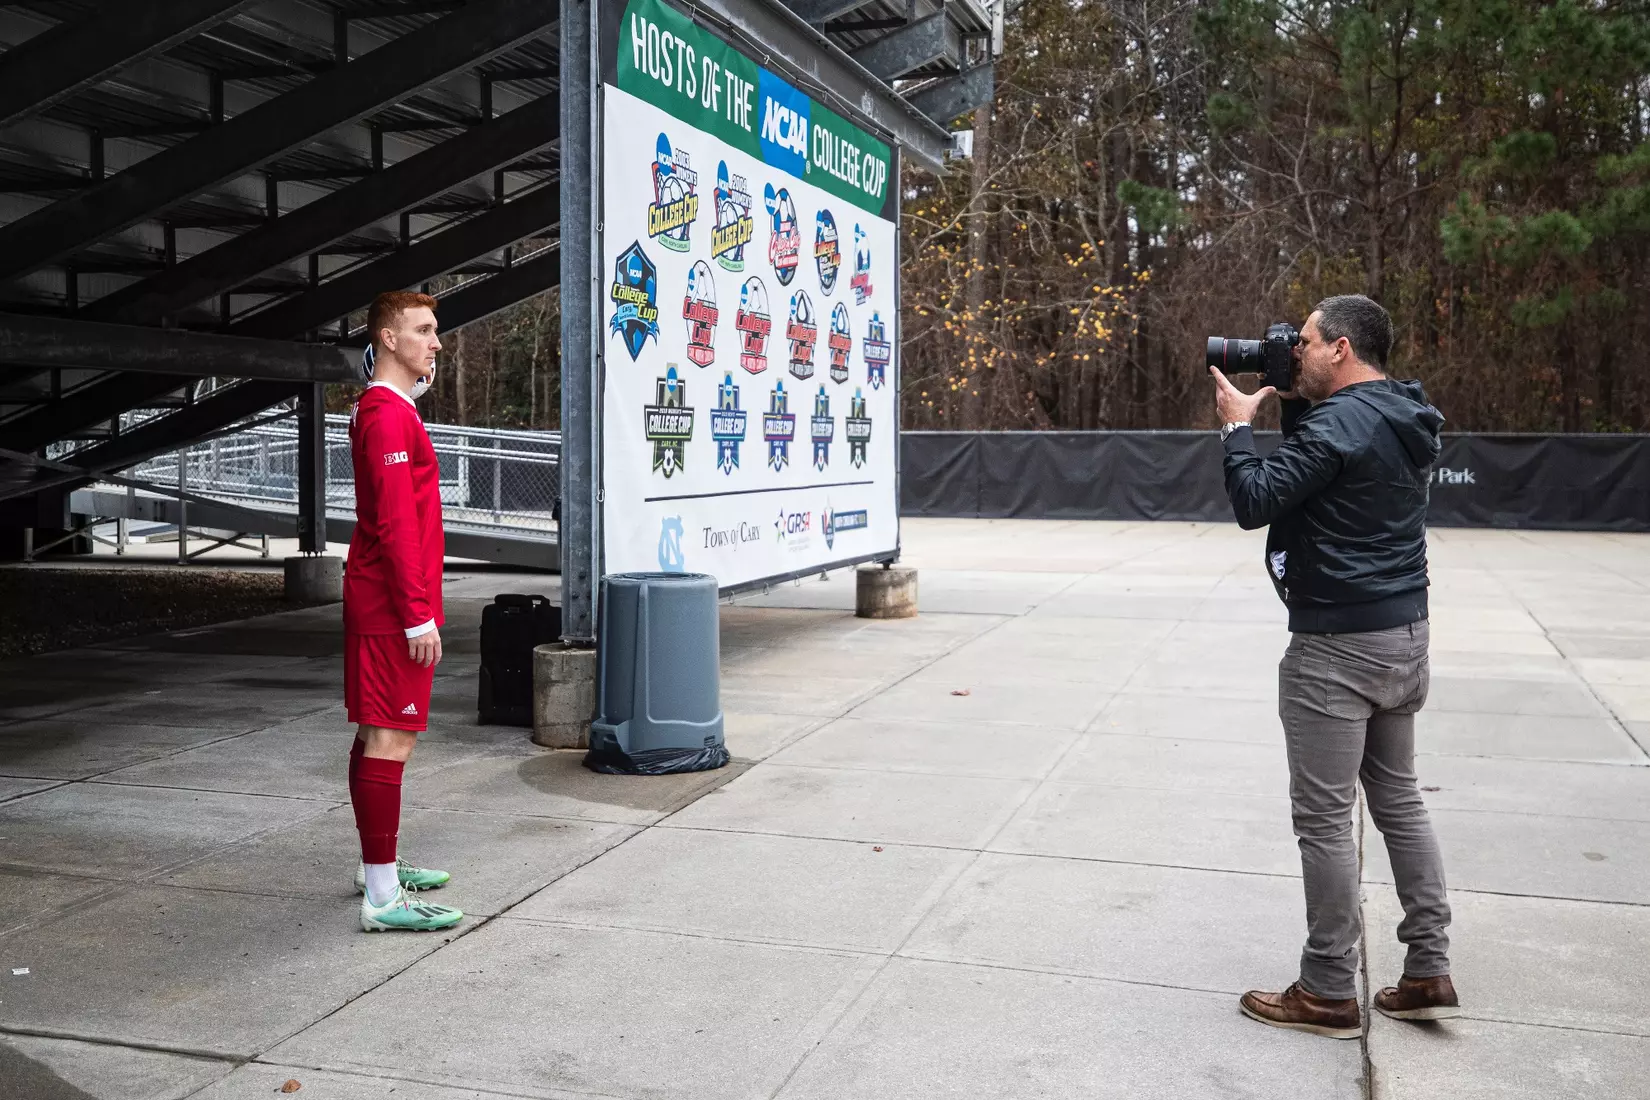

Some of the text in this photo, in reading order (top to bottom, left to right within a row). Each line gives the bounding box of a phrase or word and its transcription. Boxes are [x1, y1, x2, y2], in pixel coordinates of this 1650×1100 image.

[631, 12, 887, 199] HOSTS OF THE NCAA COLLEGE CUP
[648, 191, 699, 239] COLLEGE CUP
[711, 223, 738, 260] COLLEGE
[737, 215, 754, 245] CUP
[612, 283, 650, 307] College
[637, 303, 658, 323] Cup
[683, 296, 719, 328] College
[736, 309, 772, 338] College
[692, 321, 712, 348] Cup
[744, 332, 764, 358] Cup
[649, 414, 692, 434] COLLEGE CUP
[714, 417, 745, 435] COLLEGE CUP
[1438, 467, 1477, 485] Park
[730, 521, 741, 552] of
